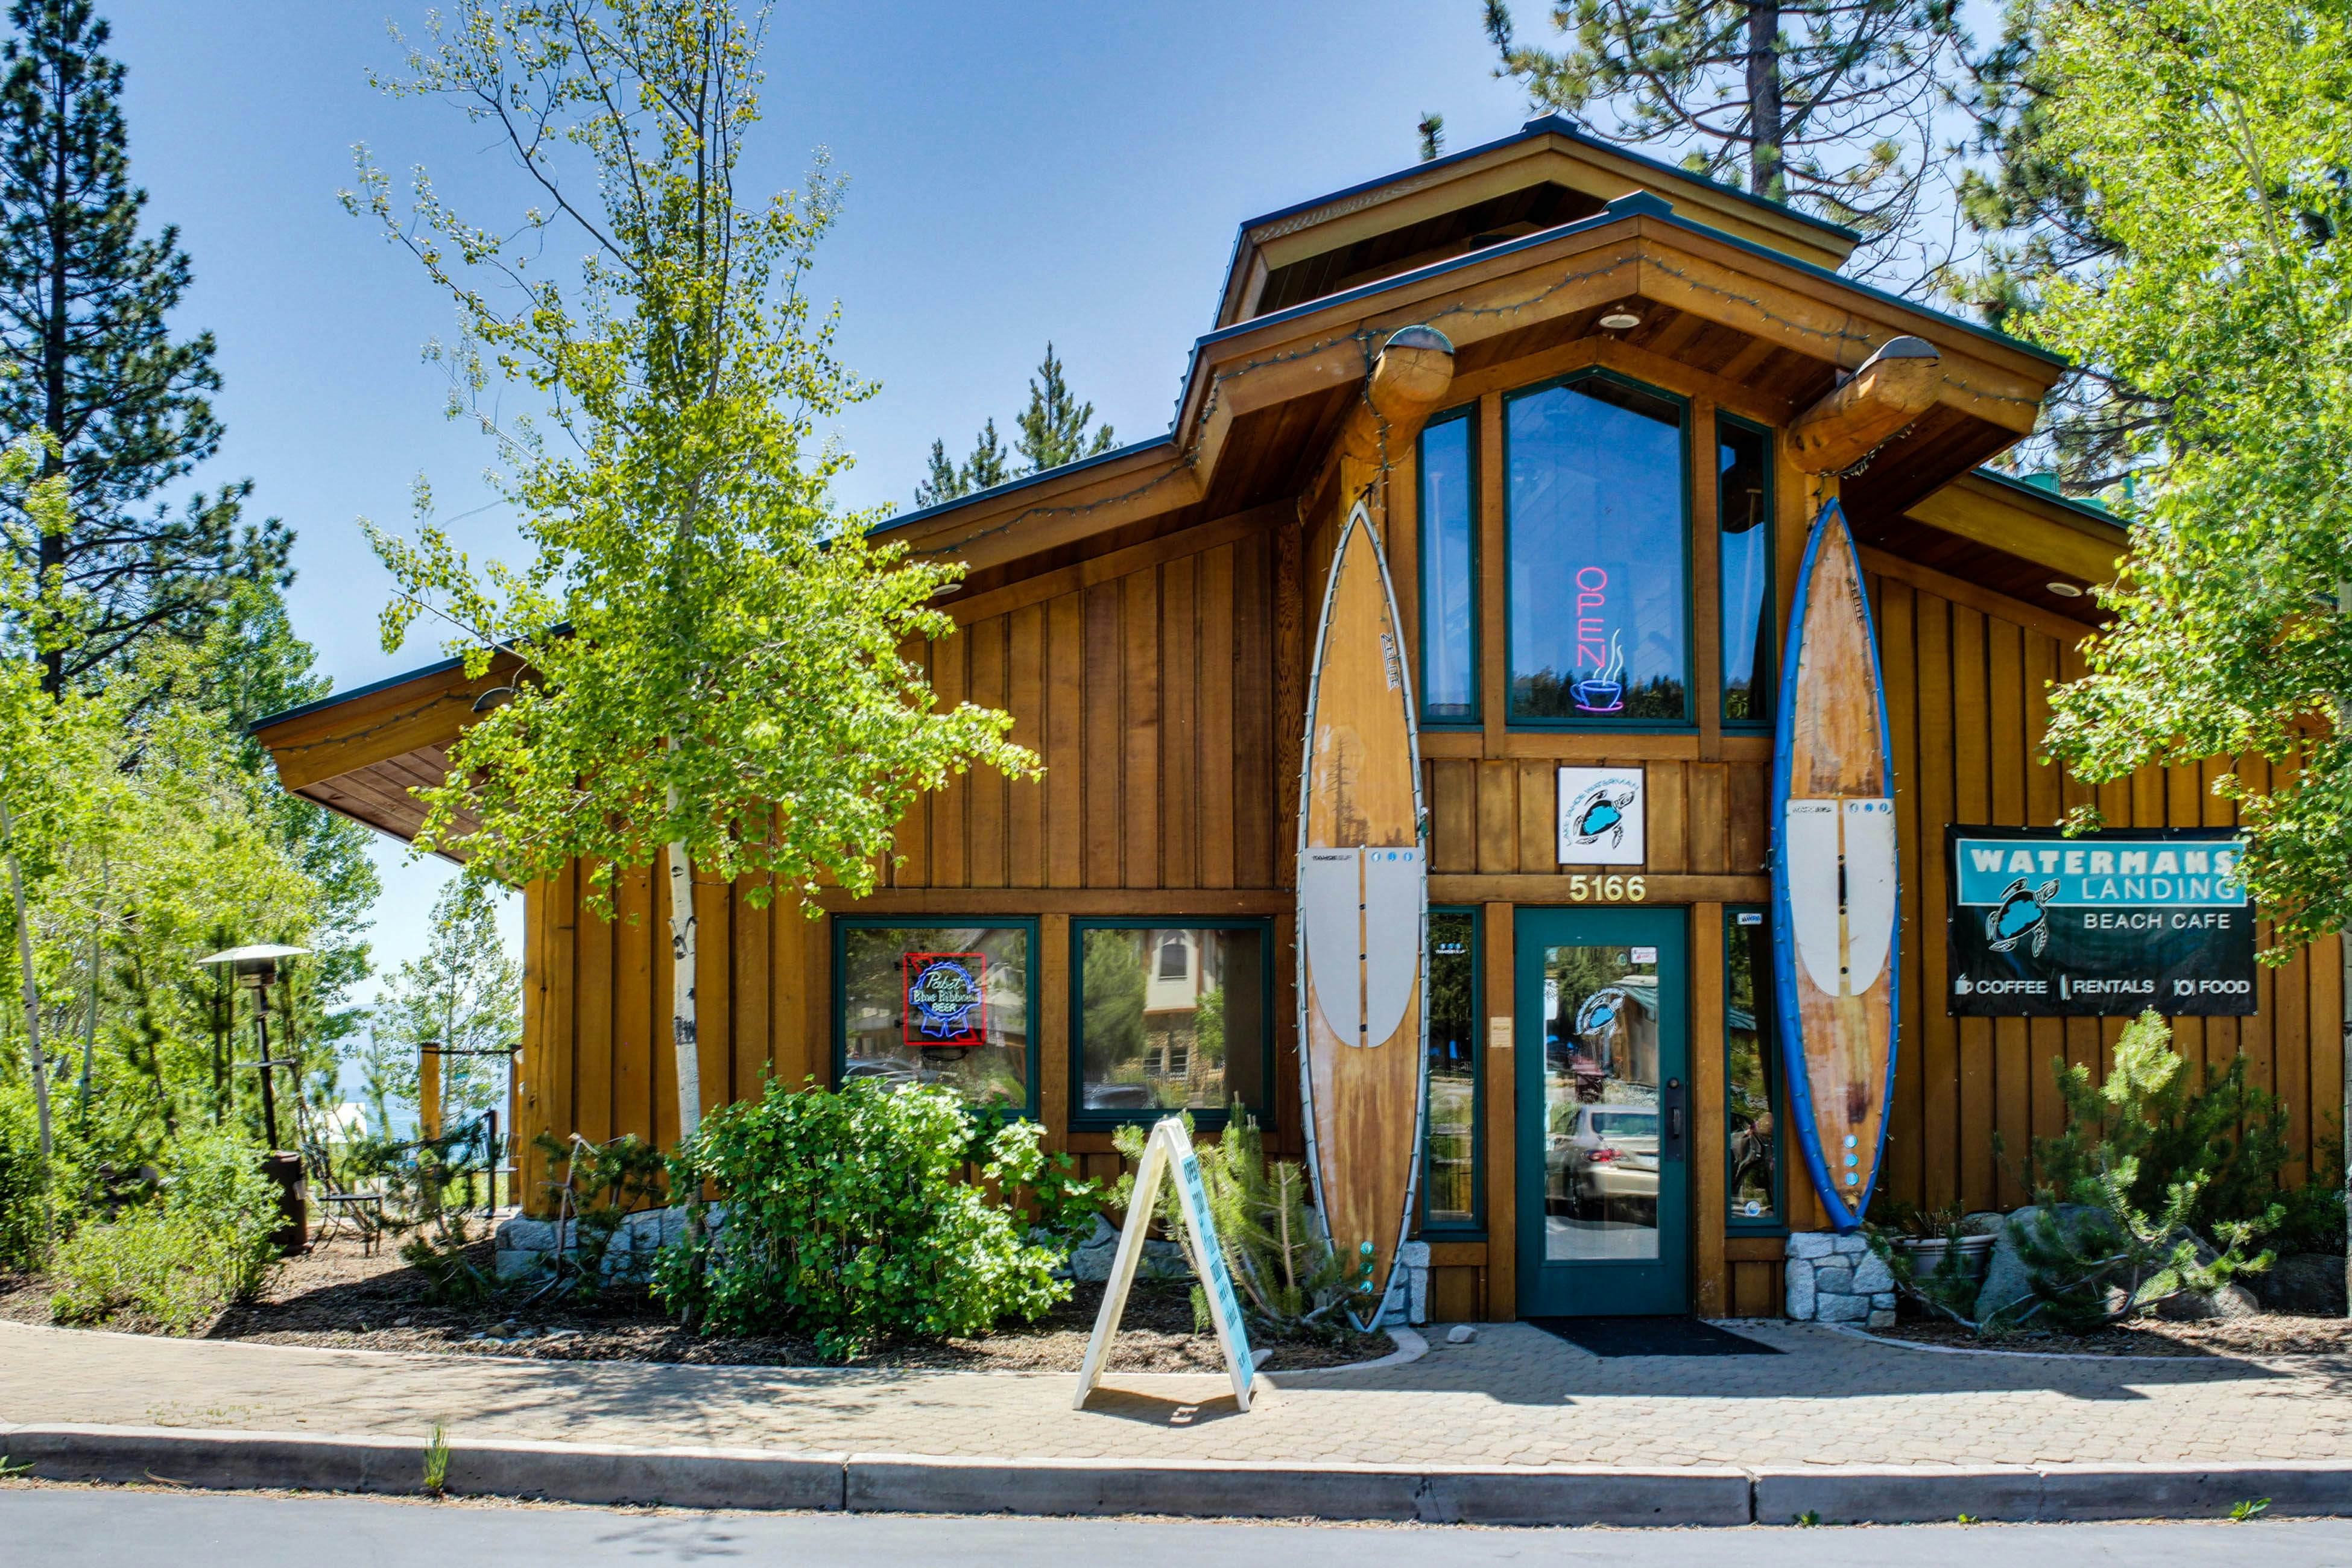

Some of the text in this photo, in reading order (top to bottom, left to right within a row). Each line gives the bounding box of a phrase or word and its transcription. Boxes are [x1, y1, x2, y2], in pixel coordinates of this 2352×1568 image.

[1576, 566, 1608, 668] OPEN
[1970, 849, 2234, 875] WATERMANS
[1569, 874, 1646, 902] 5166
[2081, 877, 2236, 900] LANDING
[2084, 914, 2231, 929] BEACH CAFE
[926, 971, 964, 990] Pabst
[1976, 979, 2251, 995] COFFEE RENTALS FOOD
[913, 990, 975, 1002] Blue Ribbon
[932, 1002, 958, 1012] BEER
